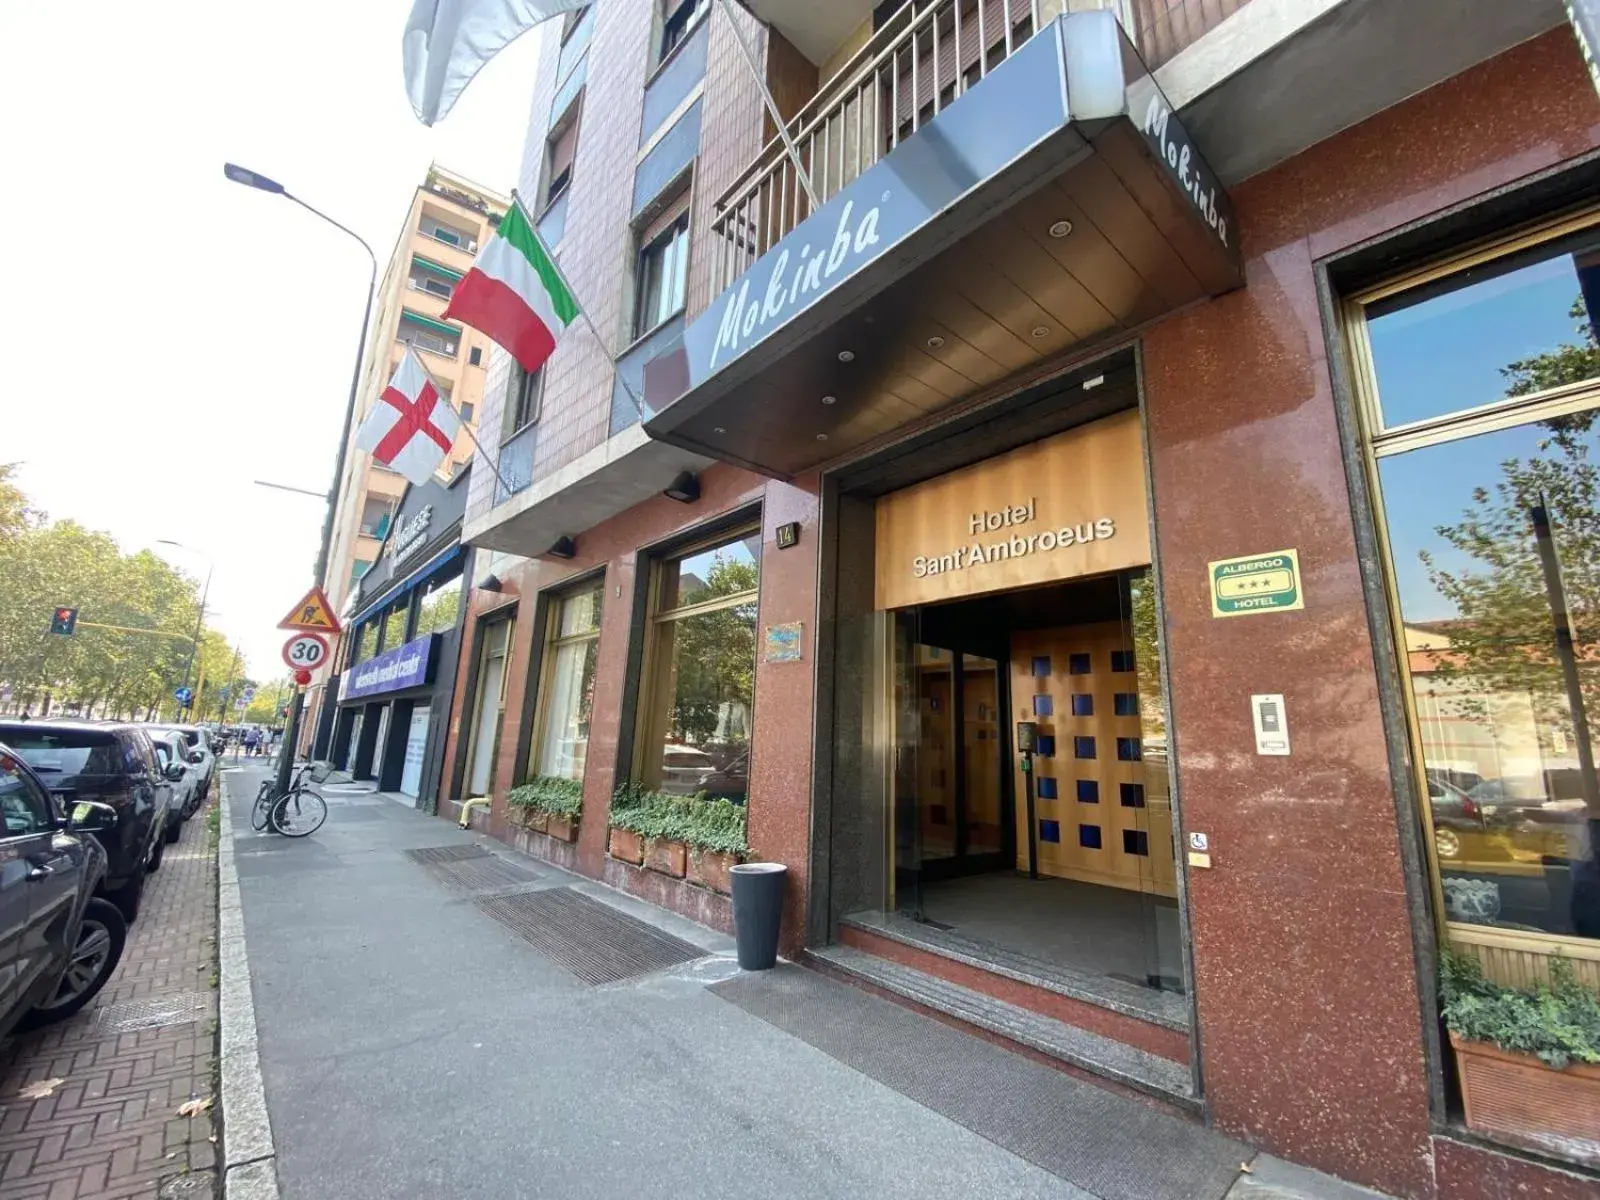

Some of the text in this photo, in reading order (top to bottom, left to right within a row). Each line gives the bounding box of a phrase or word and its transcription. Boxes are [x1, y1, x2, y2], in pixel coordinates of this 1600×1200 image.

[1145, 94, 1228, 248] Mokinba
[710, 200, 882, 369] Mokinba
[968, 496, 1037, 535] Hotel
[779, 526, 792, 544] 14
[912, 516, 1116, 578] Sant'Ambroeus
[1222, 558, 1283, 574] ALBERGO
[1234, 596, 1279, 609] HOTEL
[292, 642, 320, 662] 30
